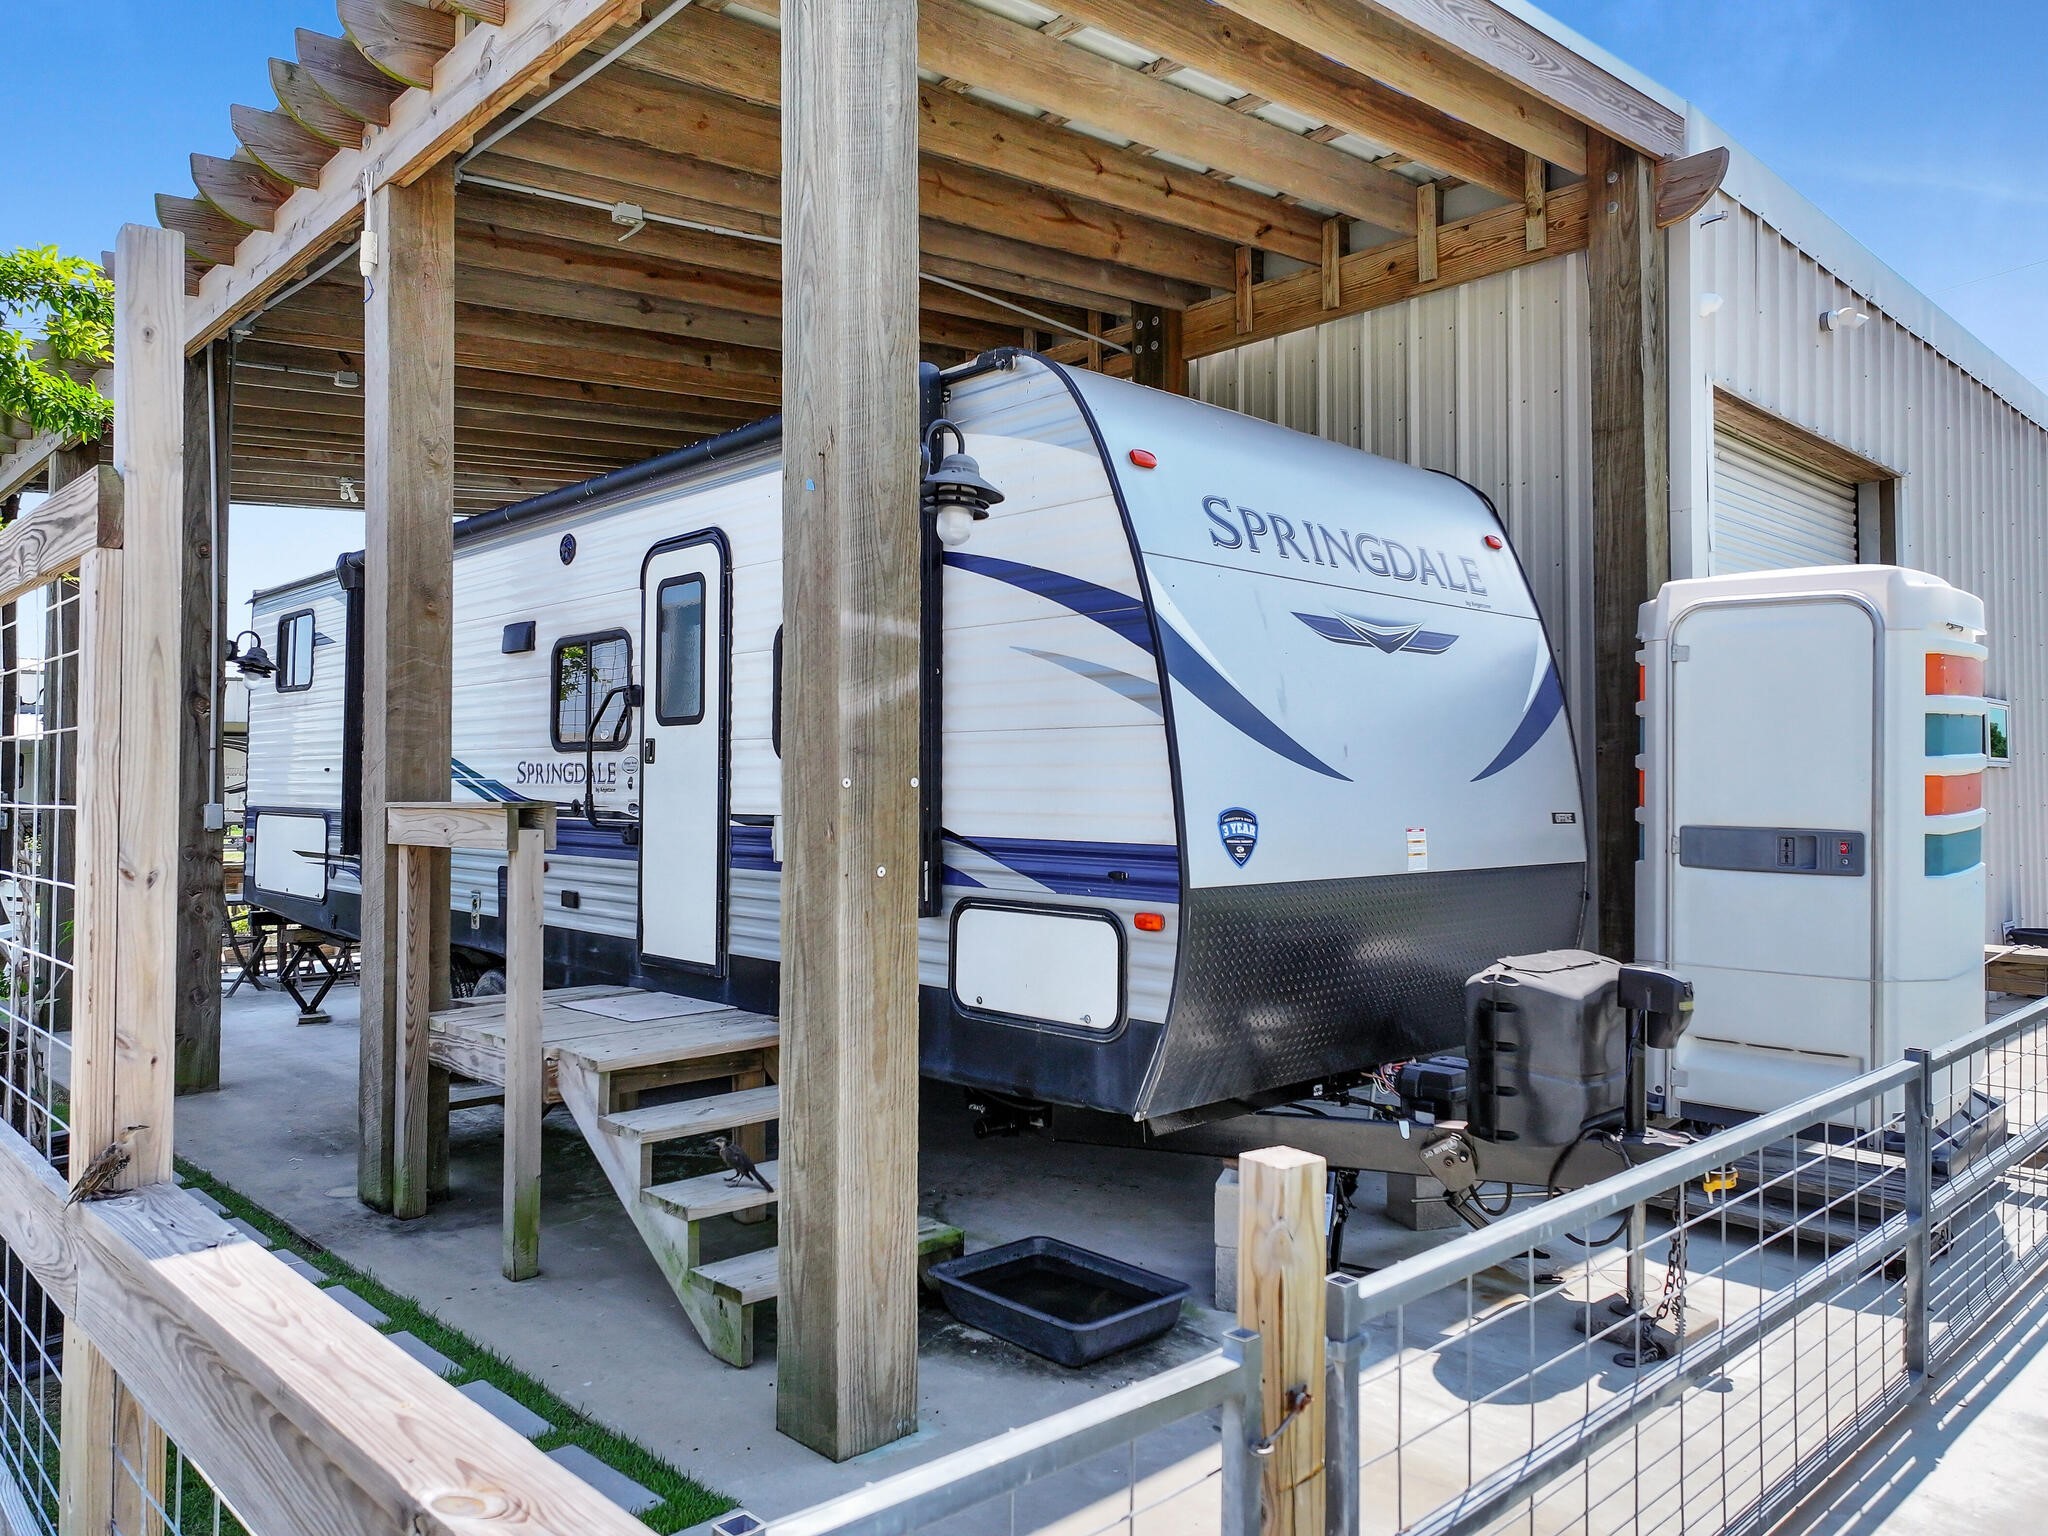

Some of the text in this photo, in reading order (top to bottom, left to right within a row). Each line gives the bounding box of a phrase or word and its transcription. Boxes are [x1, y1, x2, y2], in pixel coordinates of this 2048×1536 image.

[1201, 494, 1488, 597] SPRINGDALE
[1223, 822, 1255, 837] 3 YEAR
